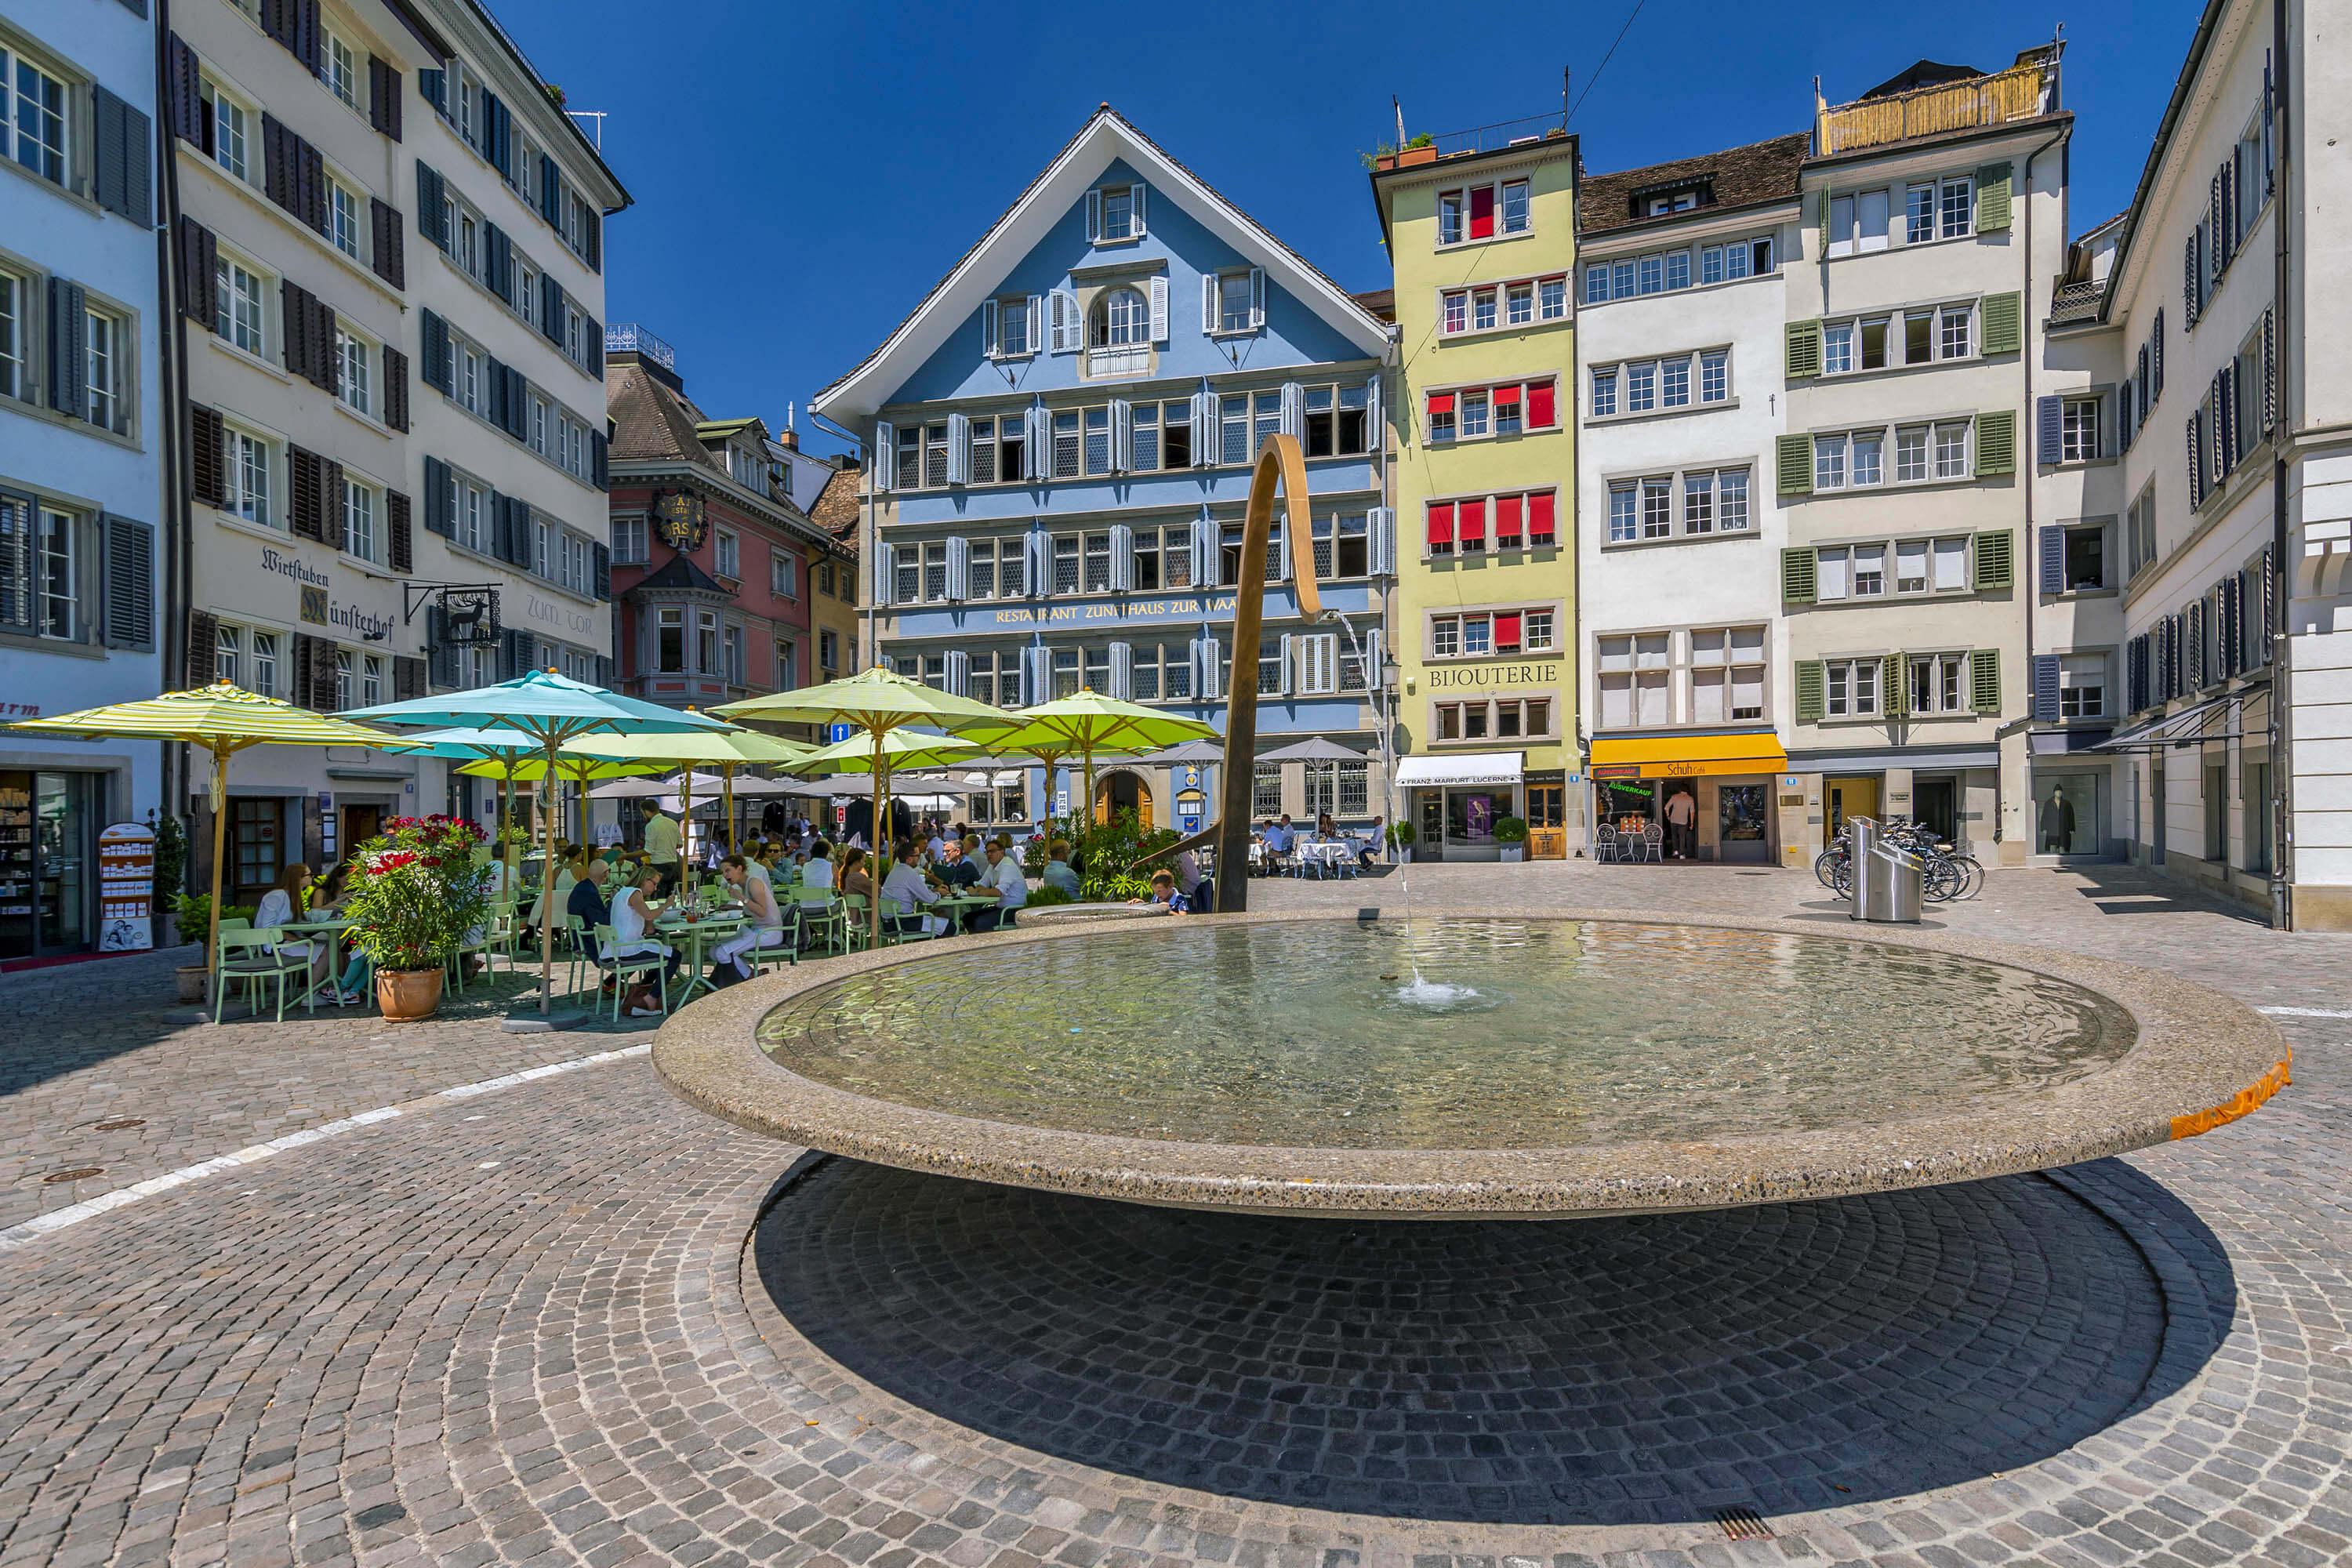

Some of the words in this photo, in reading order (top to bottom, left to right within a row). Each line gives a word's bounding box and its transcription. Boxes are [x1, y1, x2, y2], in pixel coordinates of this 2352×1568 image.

[526, 593, 562, 626] ZUM
[566, 609, 593, 635] TOR
[1171, 600, 1199, 614] ZUR
[1205, 597, 1236, 612] WAA
[1429, 664, 1558, 688] BIJOUTERIE
[1668, 762, 1693, 776] Schuh
[1608, 782, 1653, 797] AUSVERKAUF
